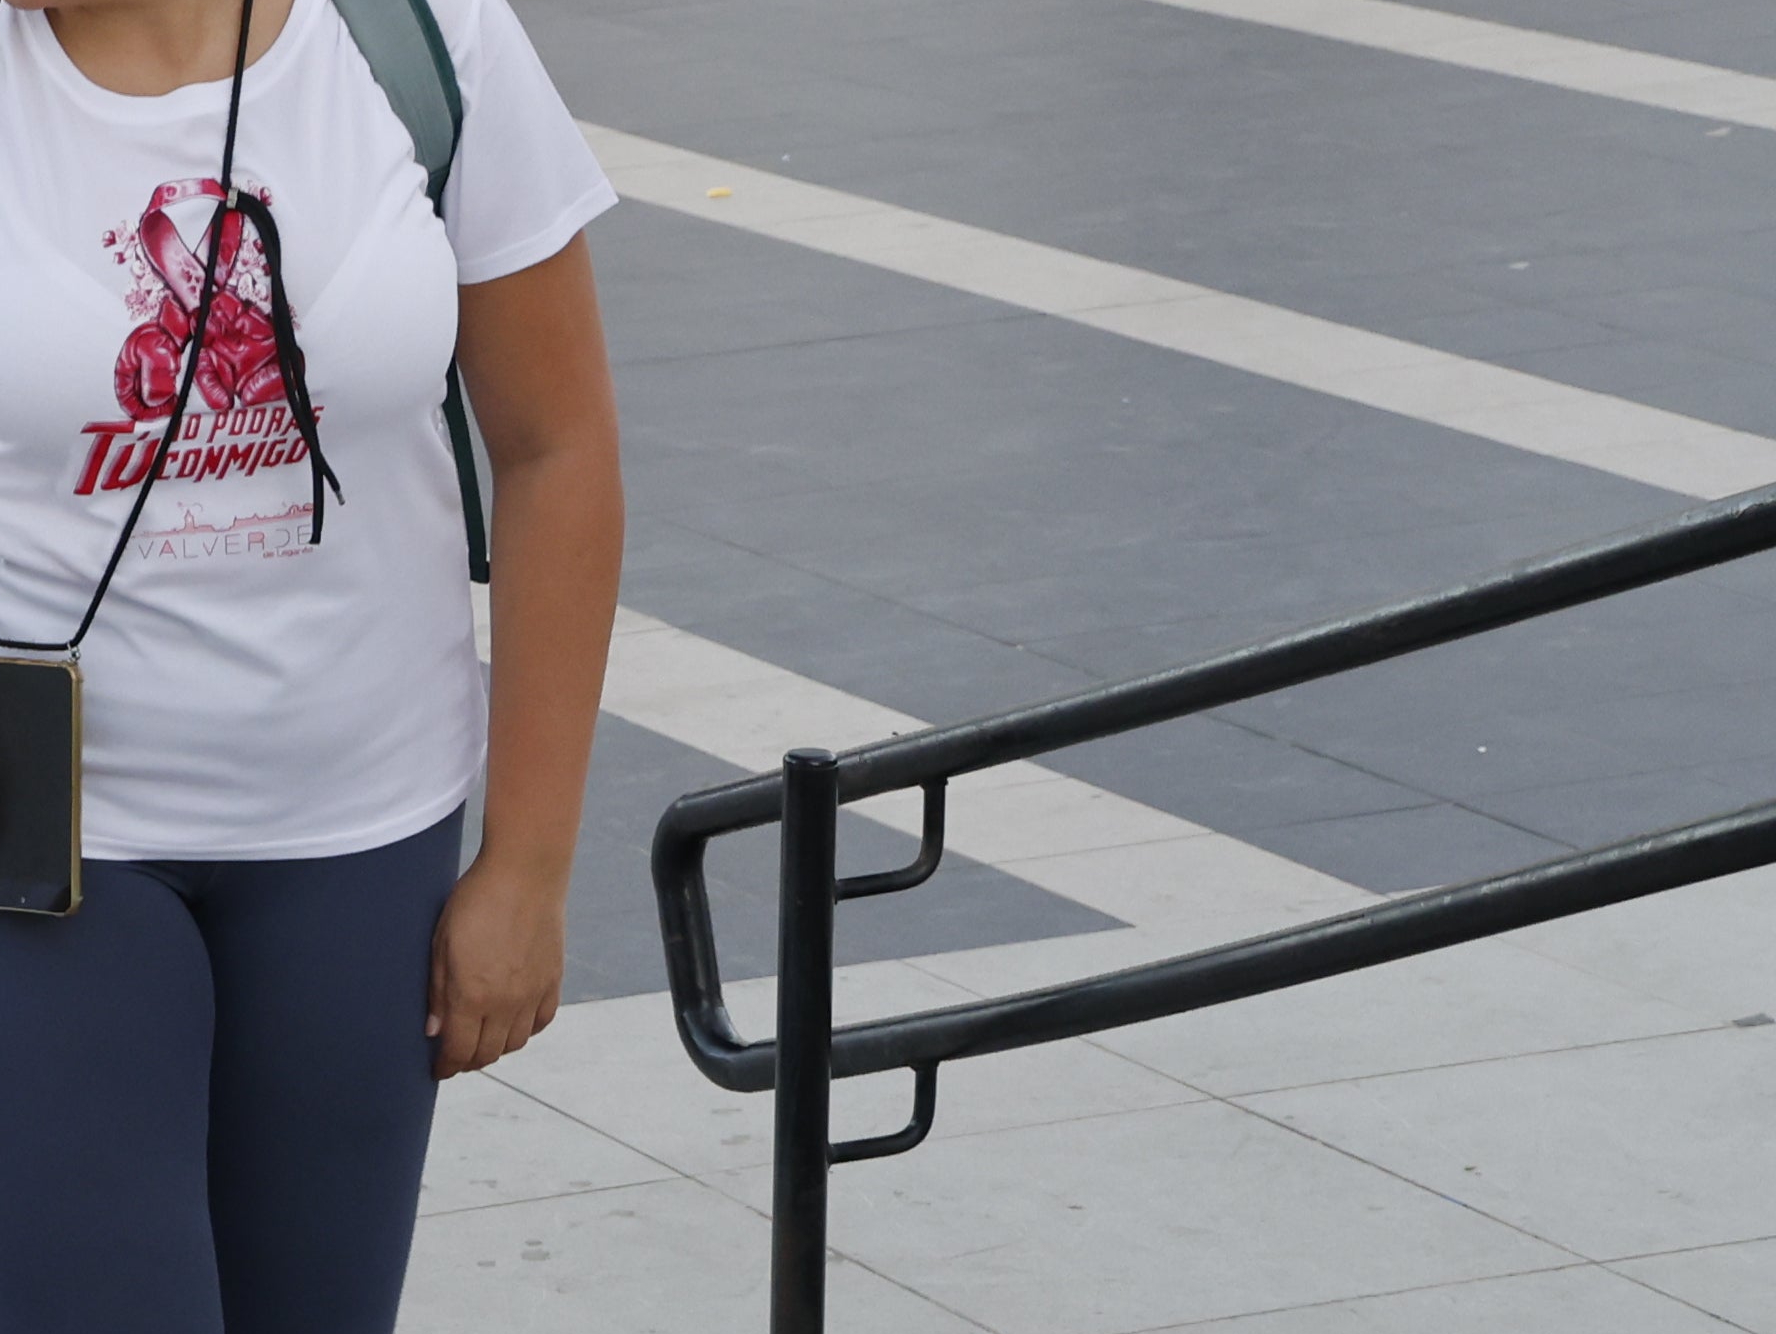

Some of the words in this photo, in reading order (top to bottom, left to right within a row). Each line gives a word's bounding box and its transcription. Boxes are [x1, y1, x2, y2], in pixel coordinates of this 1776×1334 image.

[73, 420, 161, 496] TÚ
[155, 436, 311, 483] CONMIGO
[138, 524, 313, 559] VALVERDE
